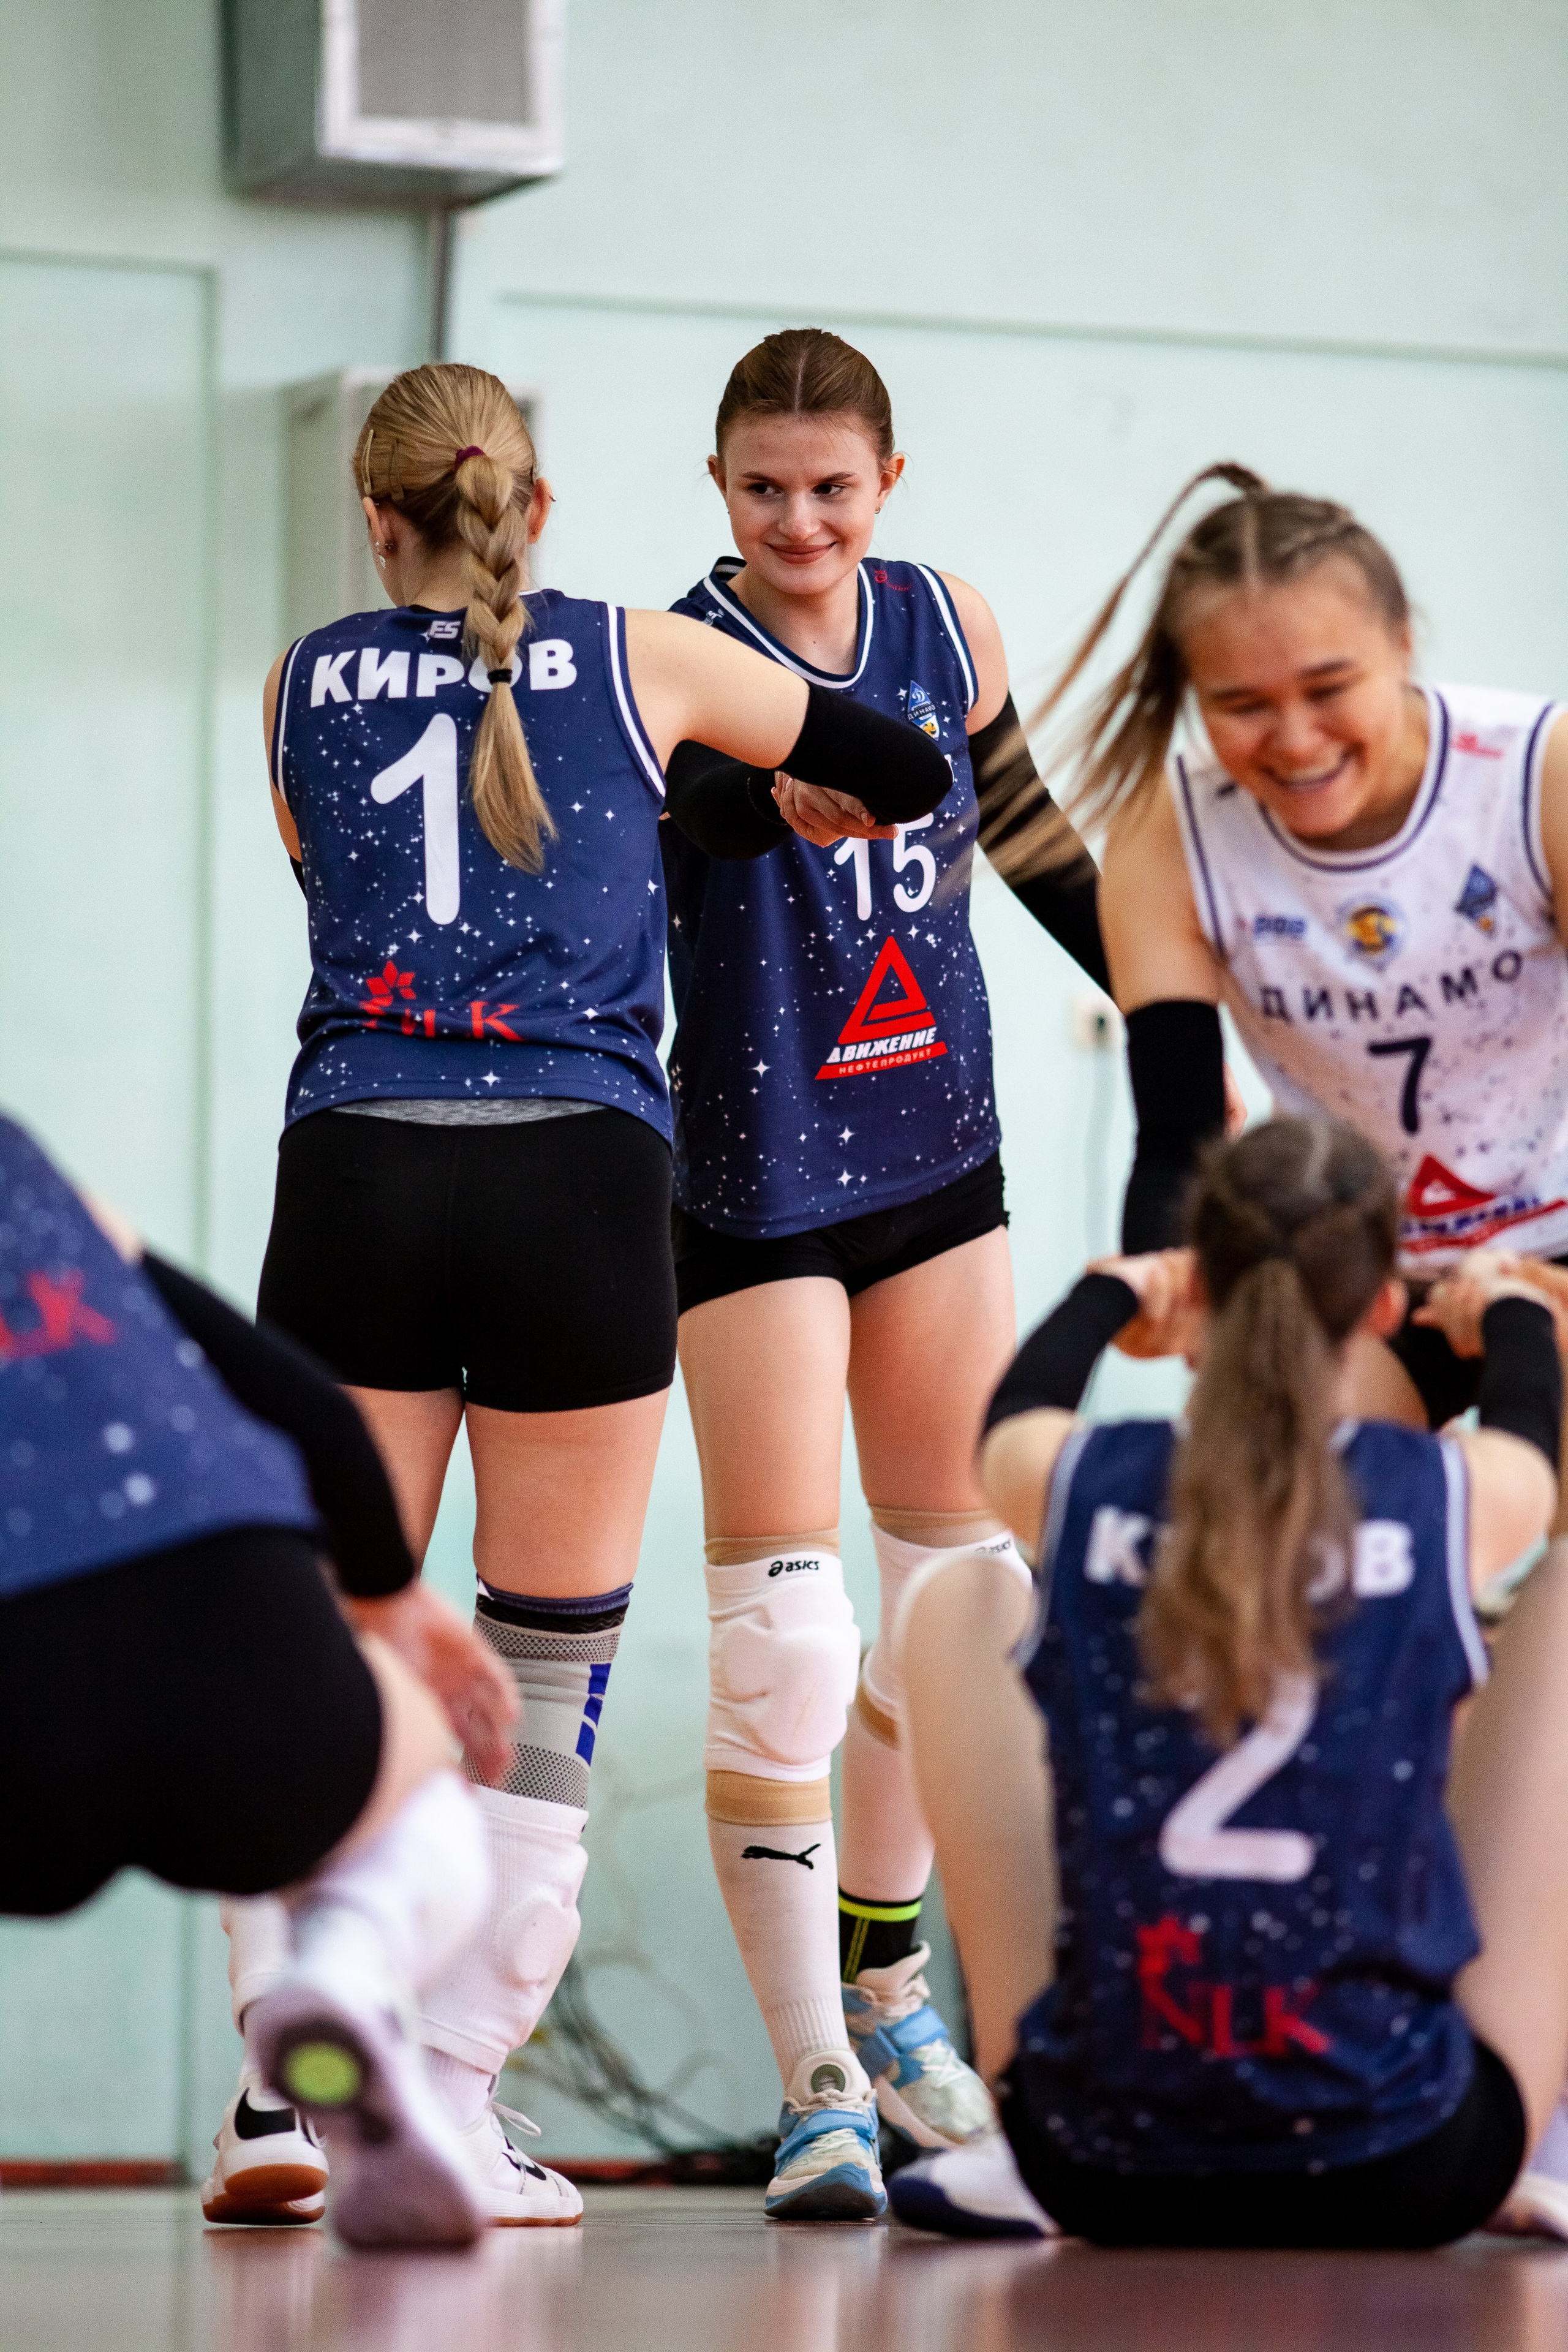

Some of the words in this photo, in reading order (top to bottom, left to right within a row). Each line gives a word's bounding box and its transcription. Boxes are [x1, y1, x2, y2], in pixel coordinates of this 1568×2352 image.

[310, 638, 578, 707] КИРОВ
[370, 712, 461, 925] 1
[834, 812, 937, 921] 15
[1261, 949, 1523, 1026] ДИНАМО
[826, 1027, 937, 1063] ДВИЖЕНИЕ
[839, 1048, 932, 1075] НЕФТЕПРОДУКТ
[1366, 1035, 1433, 1135] 7
[785, 1559, 820, 1572] asics
[1159, 1666, 1316, 1885] 2
